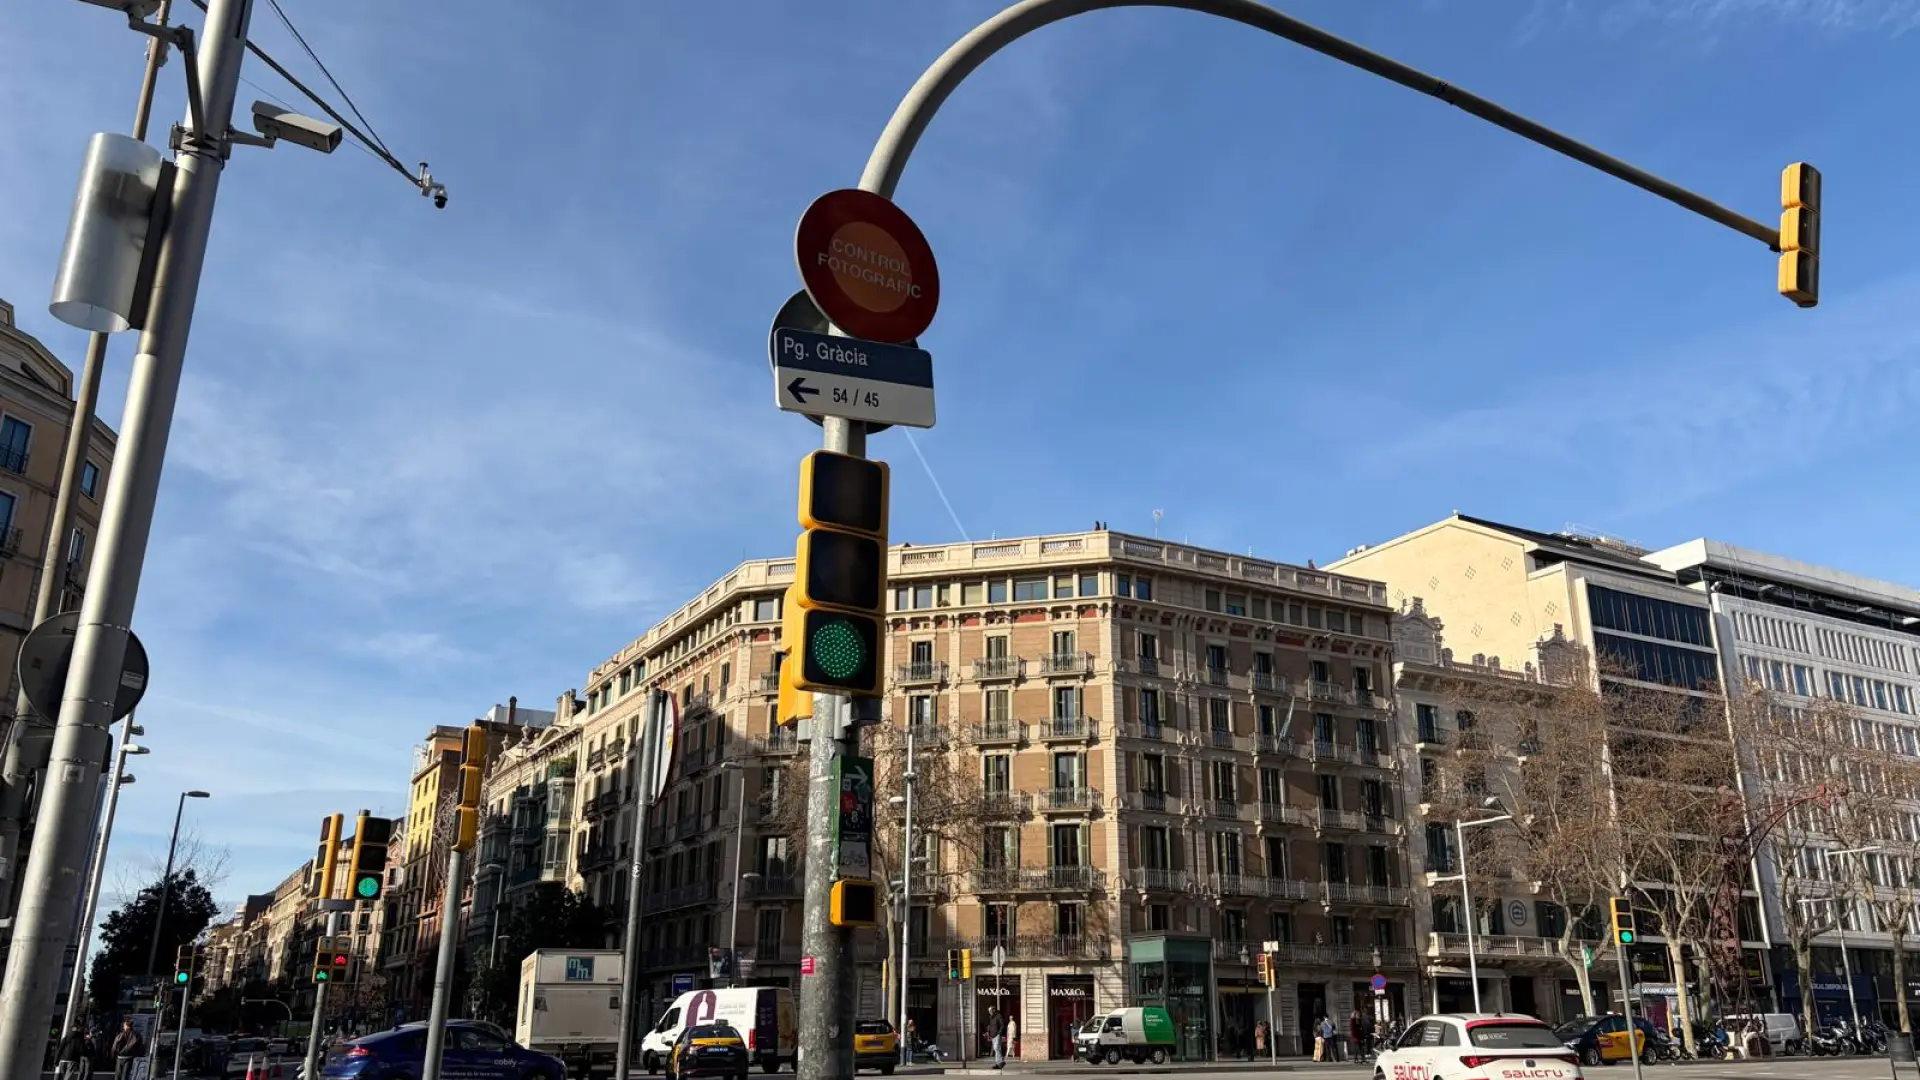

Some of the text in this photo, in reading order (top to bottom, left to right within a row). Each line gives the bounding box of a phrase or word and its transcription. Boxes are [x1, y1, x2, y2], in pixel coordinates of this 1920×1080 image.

[832, 238, 911, 277] CONTROL
[784, 336, 869, 367] Pg. Gràcia
[833, 387, 848, 404] 54
[864, 391, 880, 408] 45
